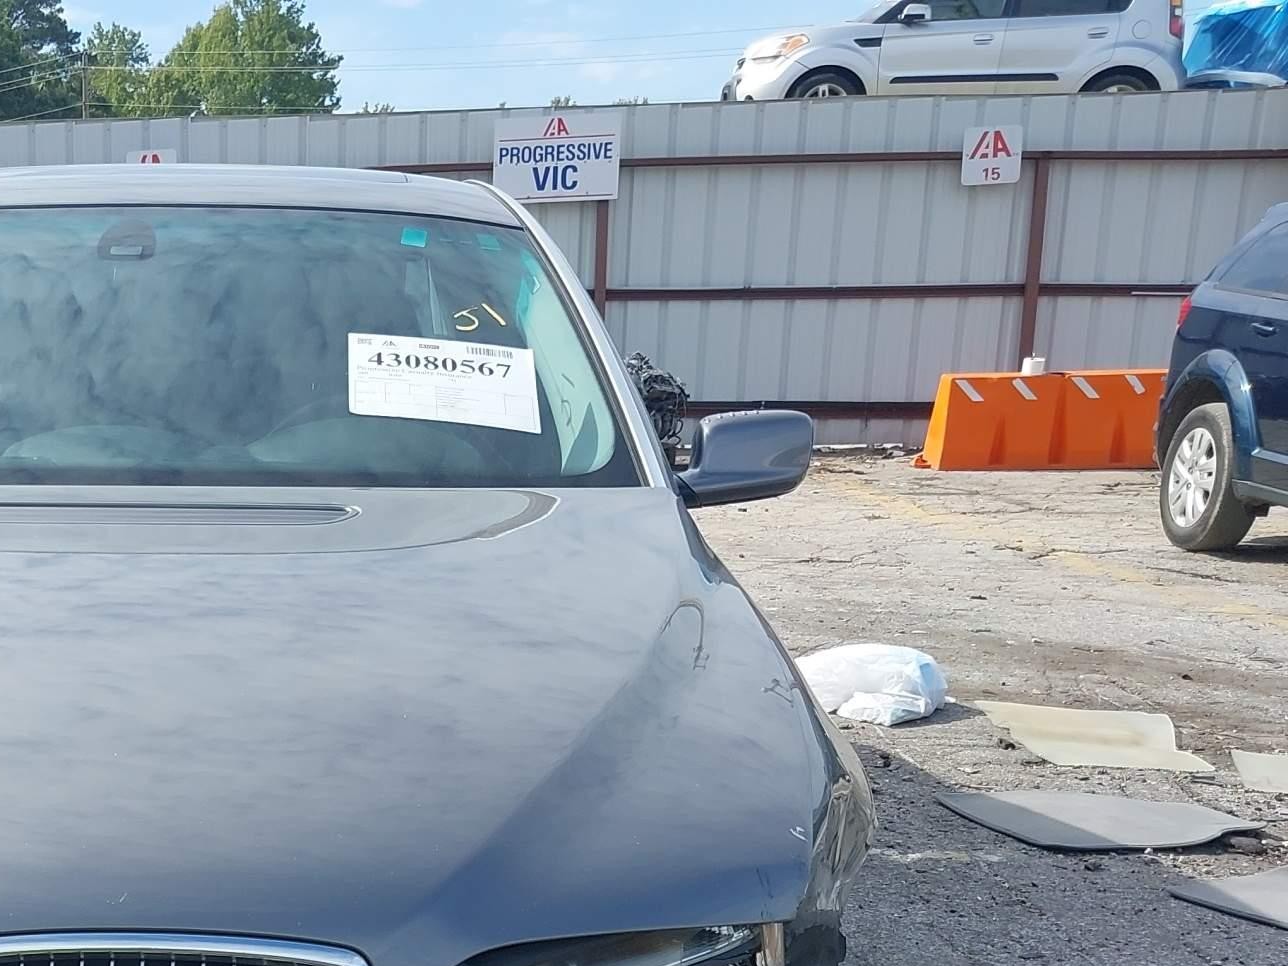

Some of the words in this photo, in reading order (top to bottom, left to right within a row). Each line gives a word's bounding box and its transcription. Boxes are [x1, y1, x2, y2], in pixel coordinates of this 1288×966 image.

[499, 141, 613, 164] PROGRESSIVE
[532, 164, 578, 191] VIC
[982, 167, 1001, 181] 15
[367, 352, 512, 379] 43080567
